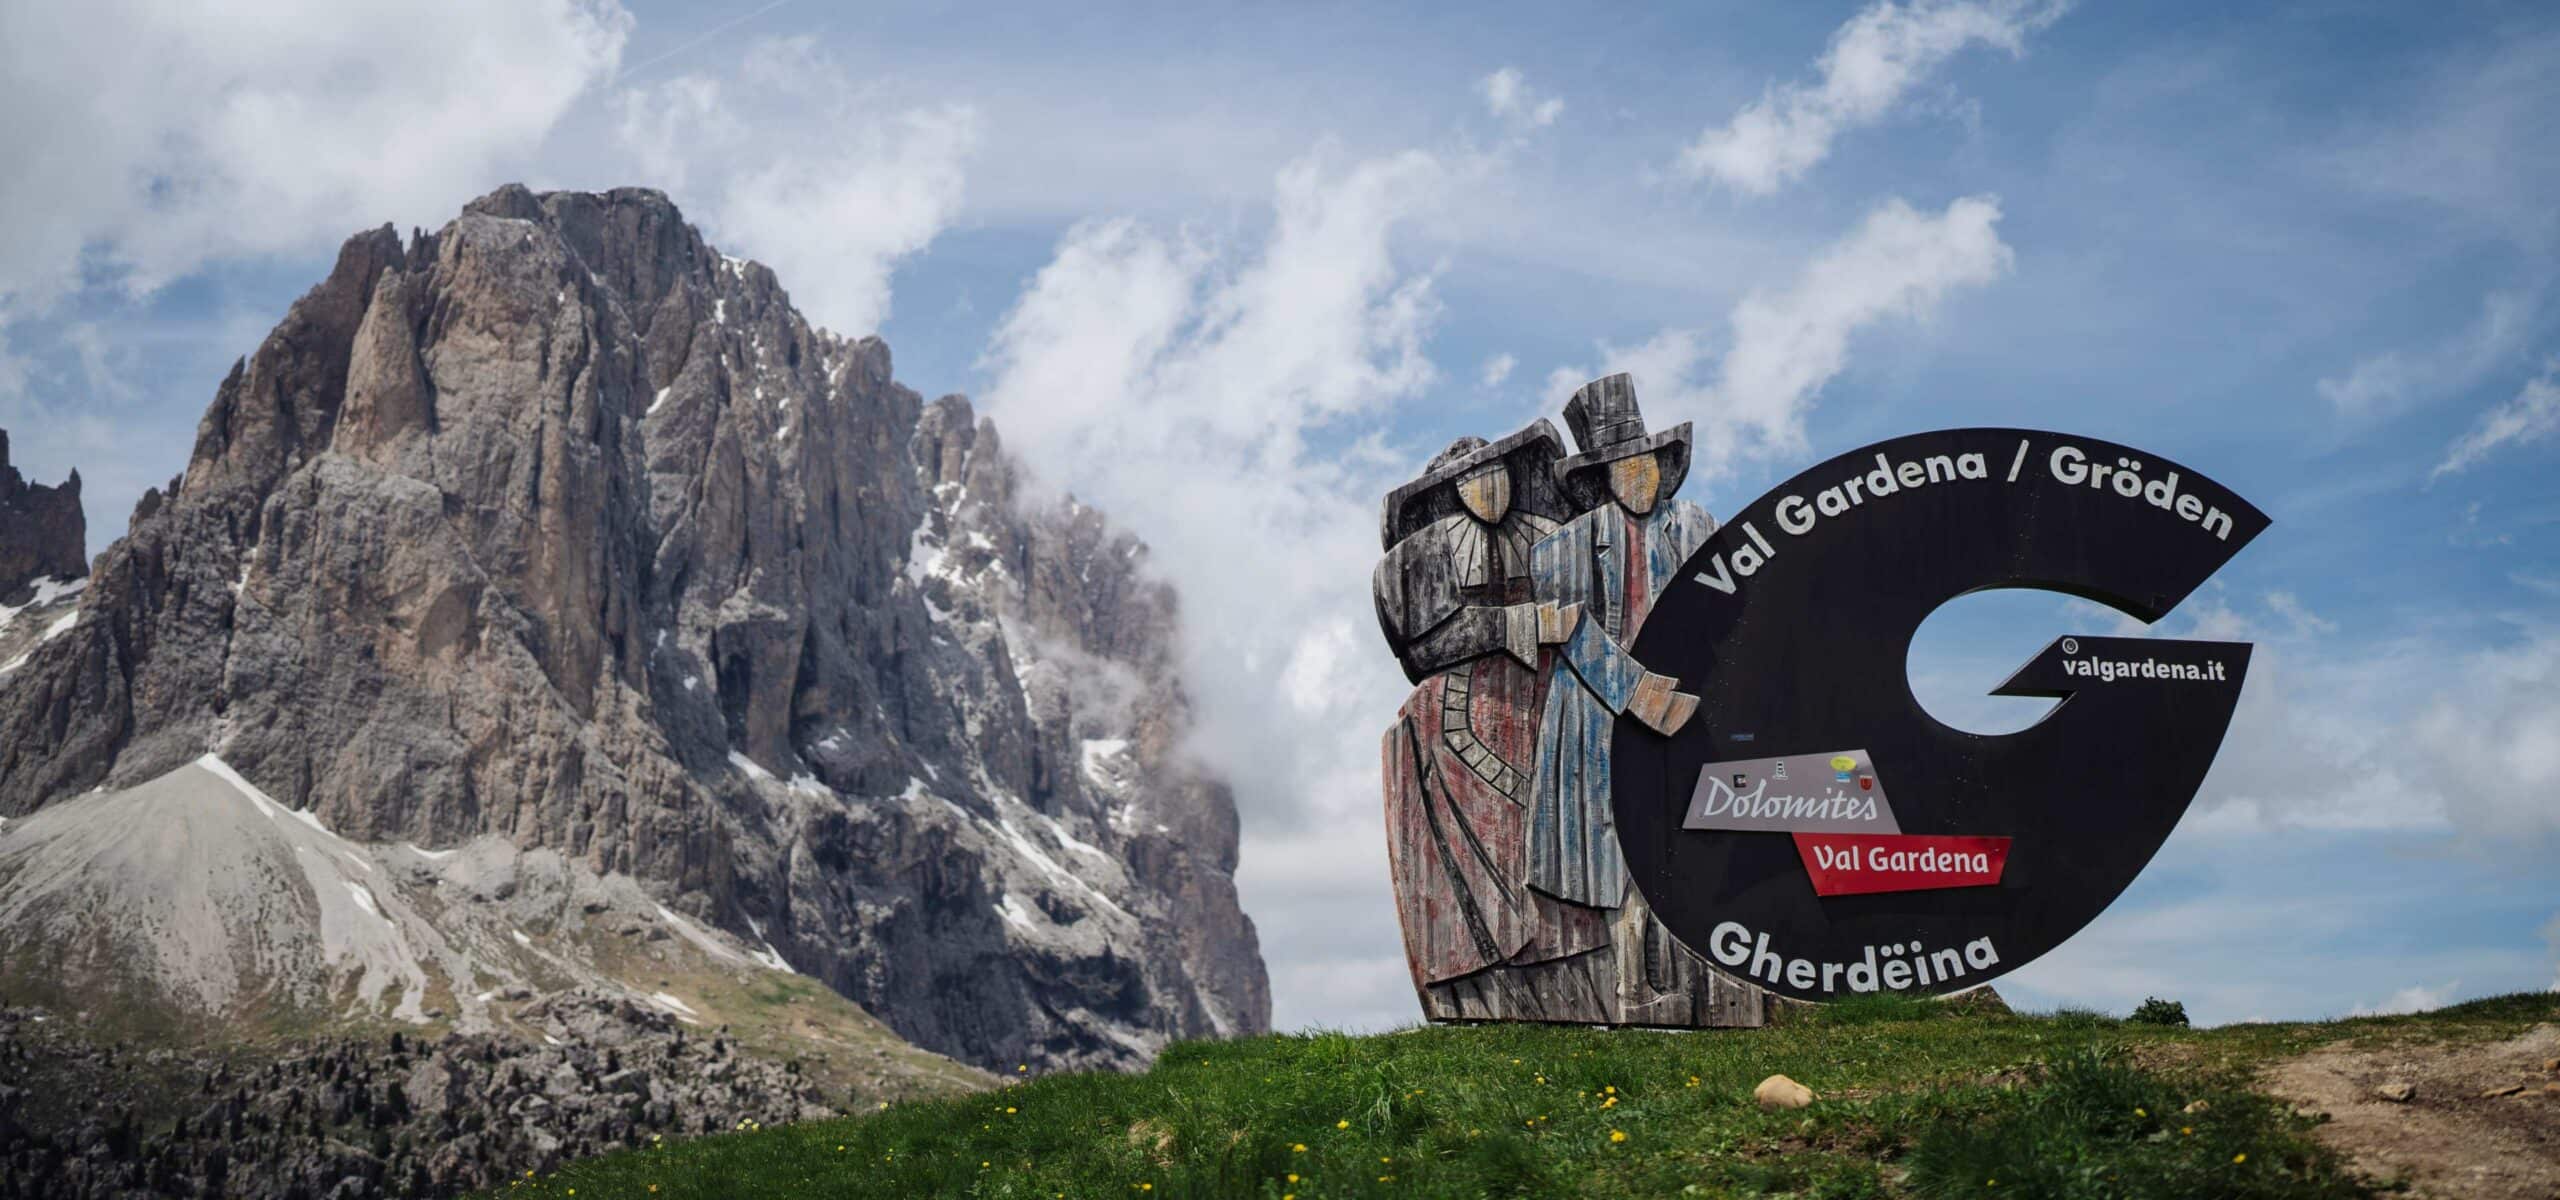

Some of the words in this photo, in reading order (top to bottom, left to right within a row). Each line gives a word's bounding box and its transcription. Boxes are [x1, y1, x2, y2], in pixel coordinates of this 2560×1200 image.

[1694, 522, 1776, 595] Val
[1775, 452, 1989, 536] Gardena
[2007, 439, 2030, 482] /
[2049, 446, 2234, 541] Gröden
[2063, 656, 2226, 682] valgardena.it
[1703, 775, 1877, 820] Dolomites
[1812, 845, 1860, 871] Val
[1868, 846, 1989, 873] Gardena
[1709, 921, 2000, 992] Gherdëina
